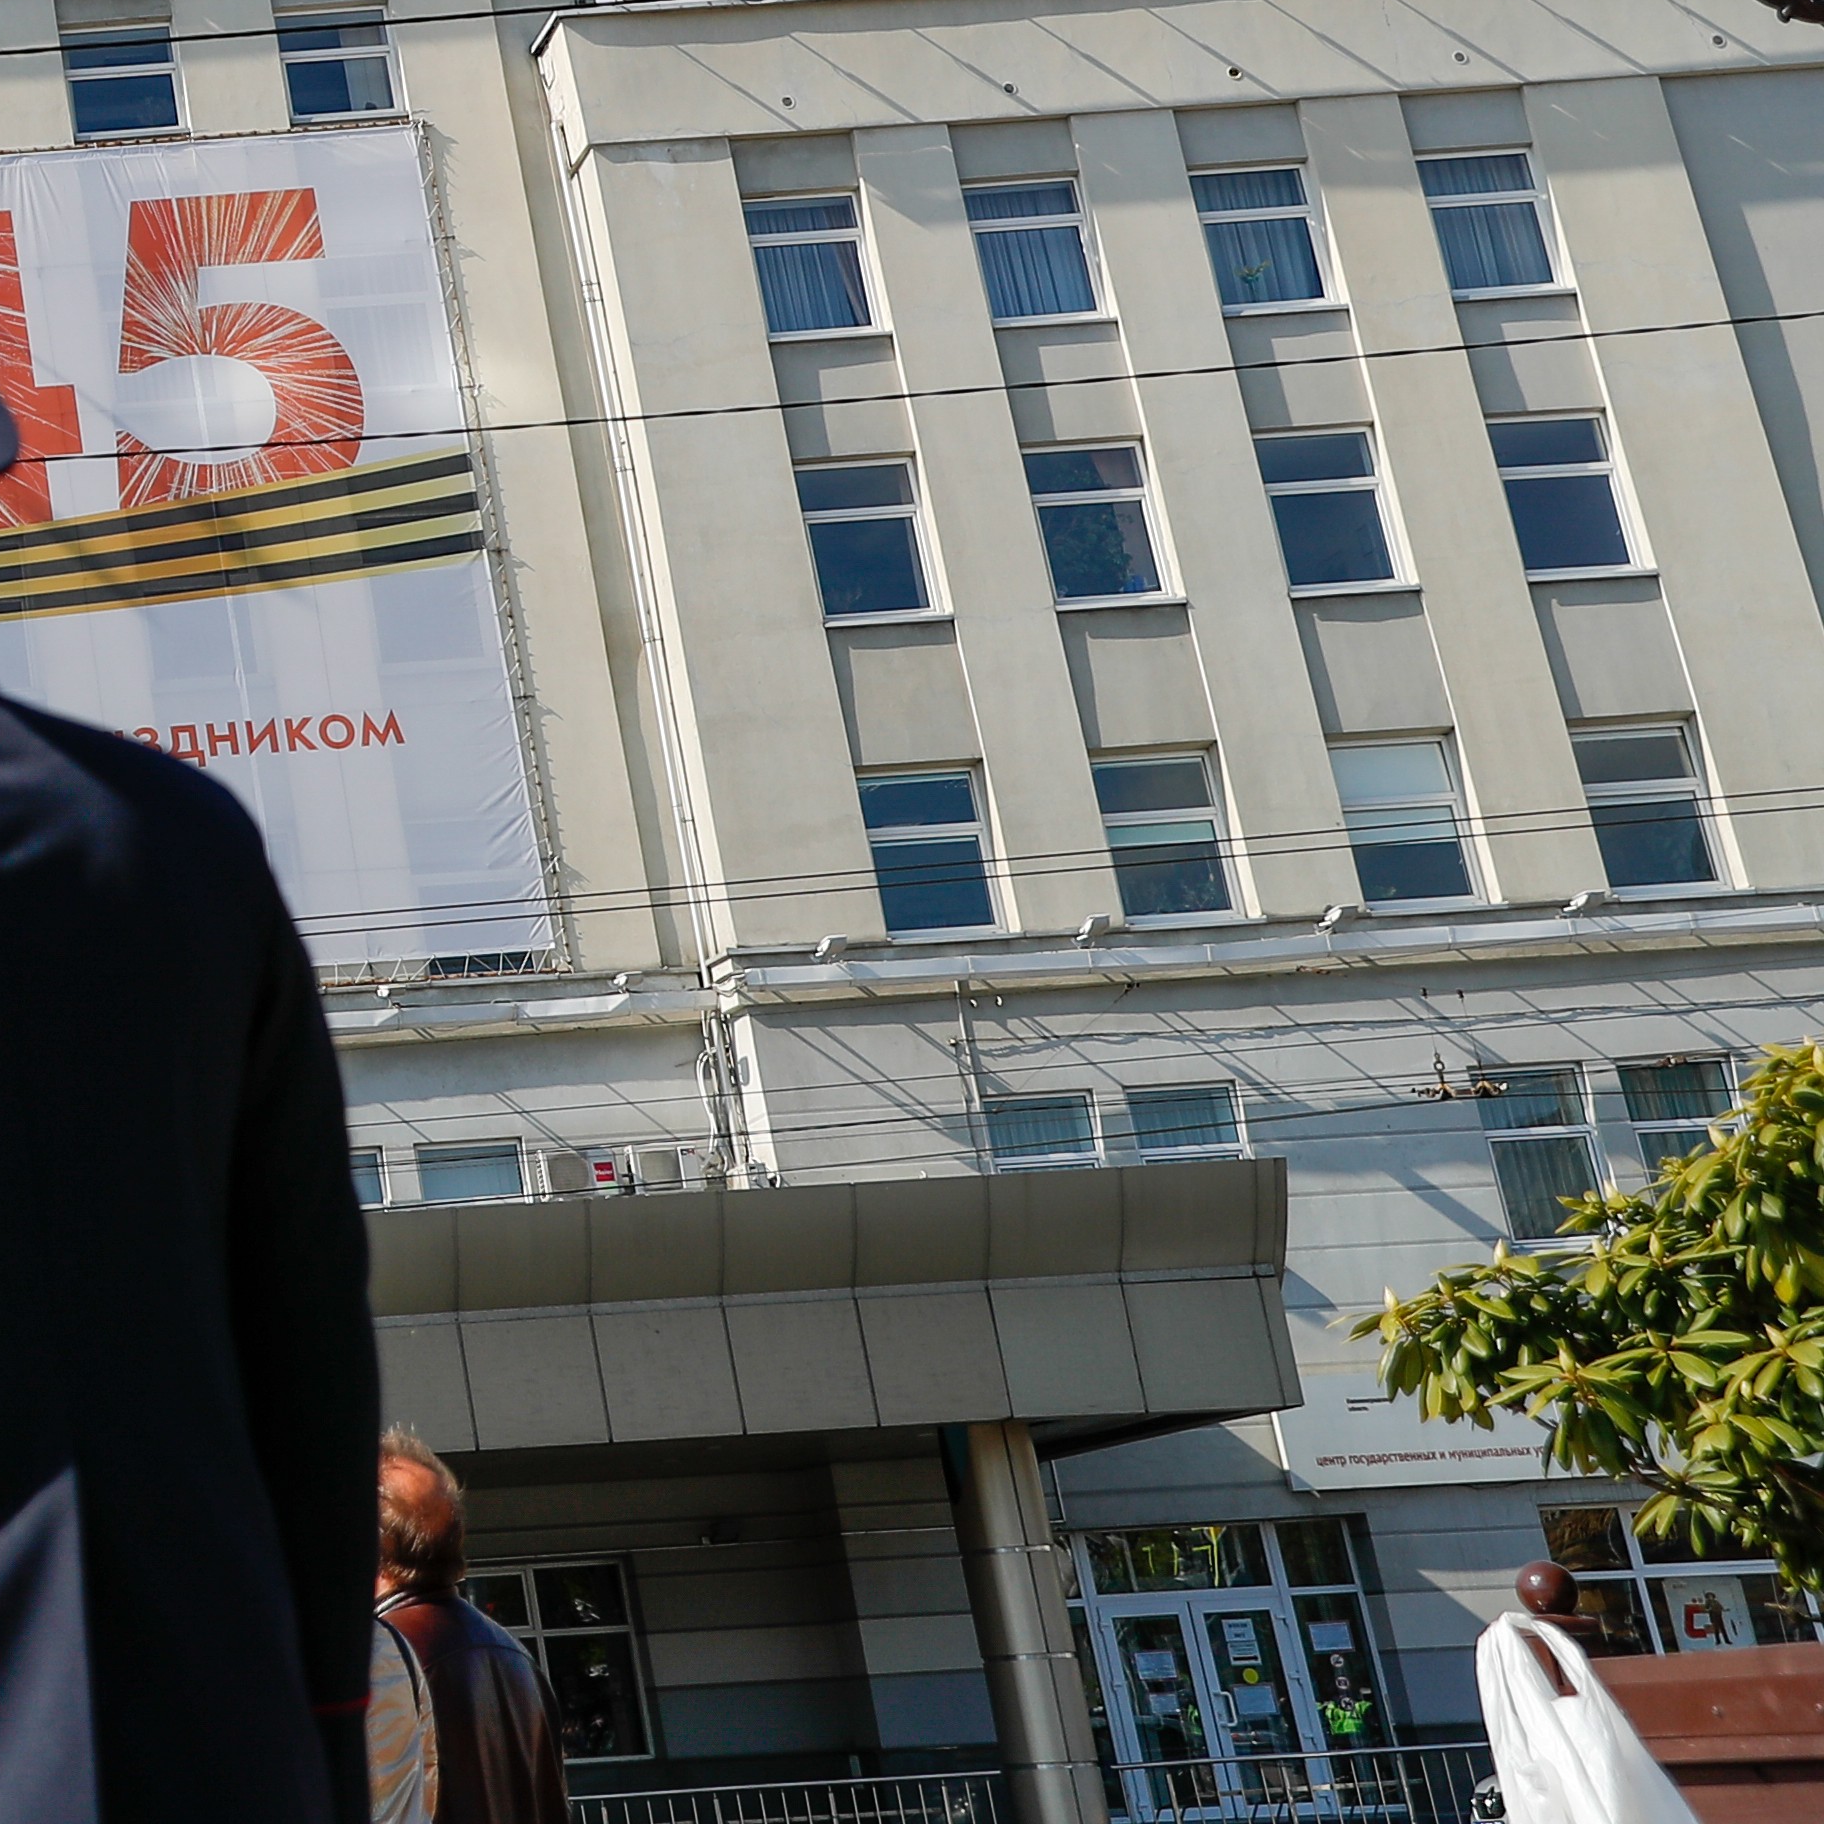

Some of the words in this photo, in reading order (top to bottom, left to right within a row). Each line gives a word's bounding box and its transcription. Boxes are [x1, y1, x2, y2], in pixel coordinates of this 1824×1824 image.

[109, 709, 406, 768] здником
[1315, 1455, 1347, 1467] центр
[1348, 1451, 1437, 1467] государственных
[1448, 1446, 1532, 1462] муниципальных
